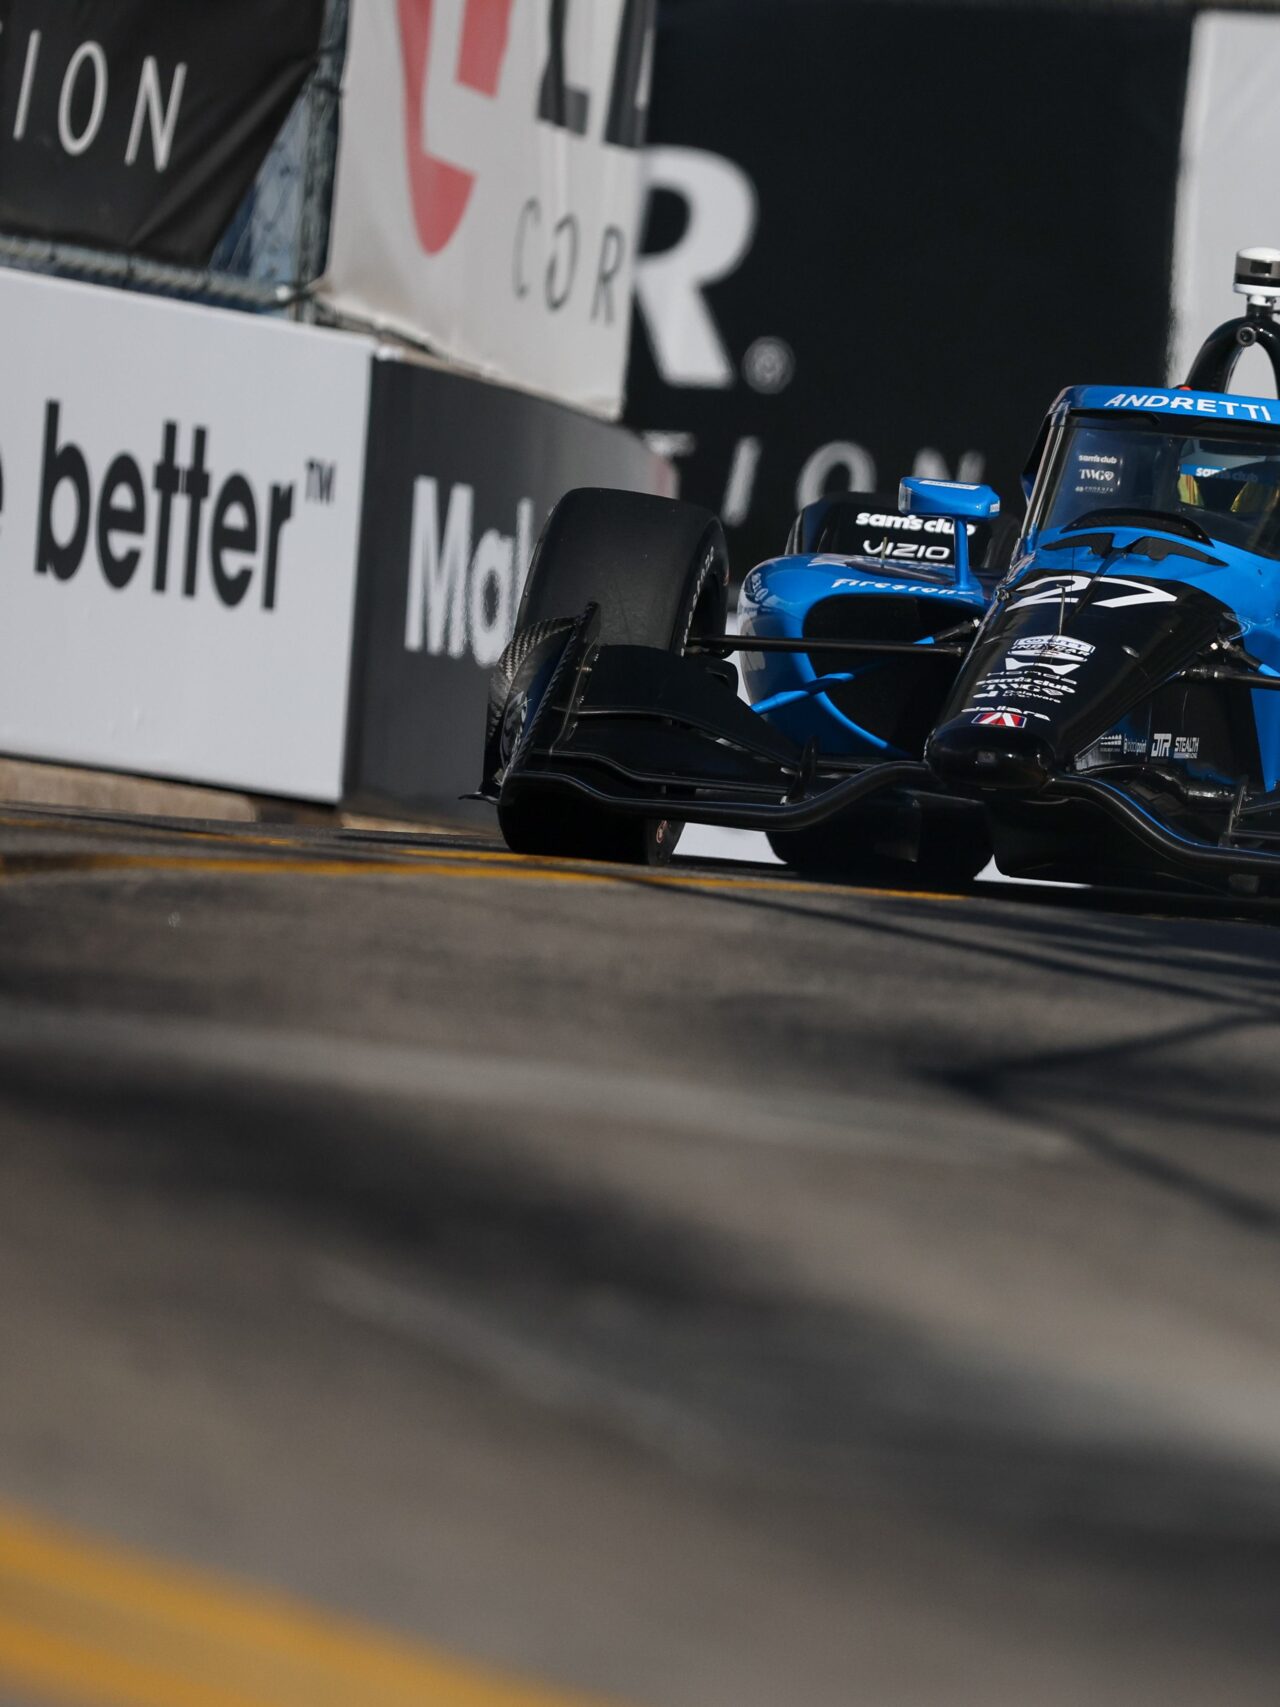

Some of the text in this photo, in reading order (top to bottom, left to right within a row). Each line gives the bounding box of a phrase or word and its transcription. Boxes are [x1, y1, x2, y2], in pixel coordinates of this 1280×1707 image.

[1103, 393, 1272, 421] ANDRETTI
[34, 399, 293, 610] better
[856, 511, 924, 531] sam's
[862, 539, 950, 561] VIZIO
[1004, 574, 1178, 612] 27
